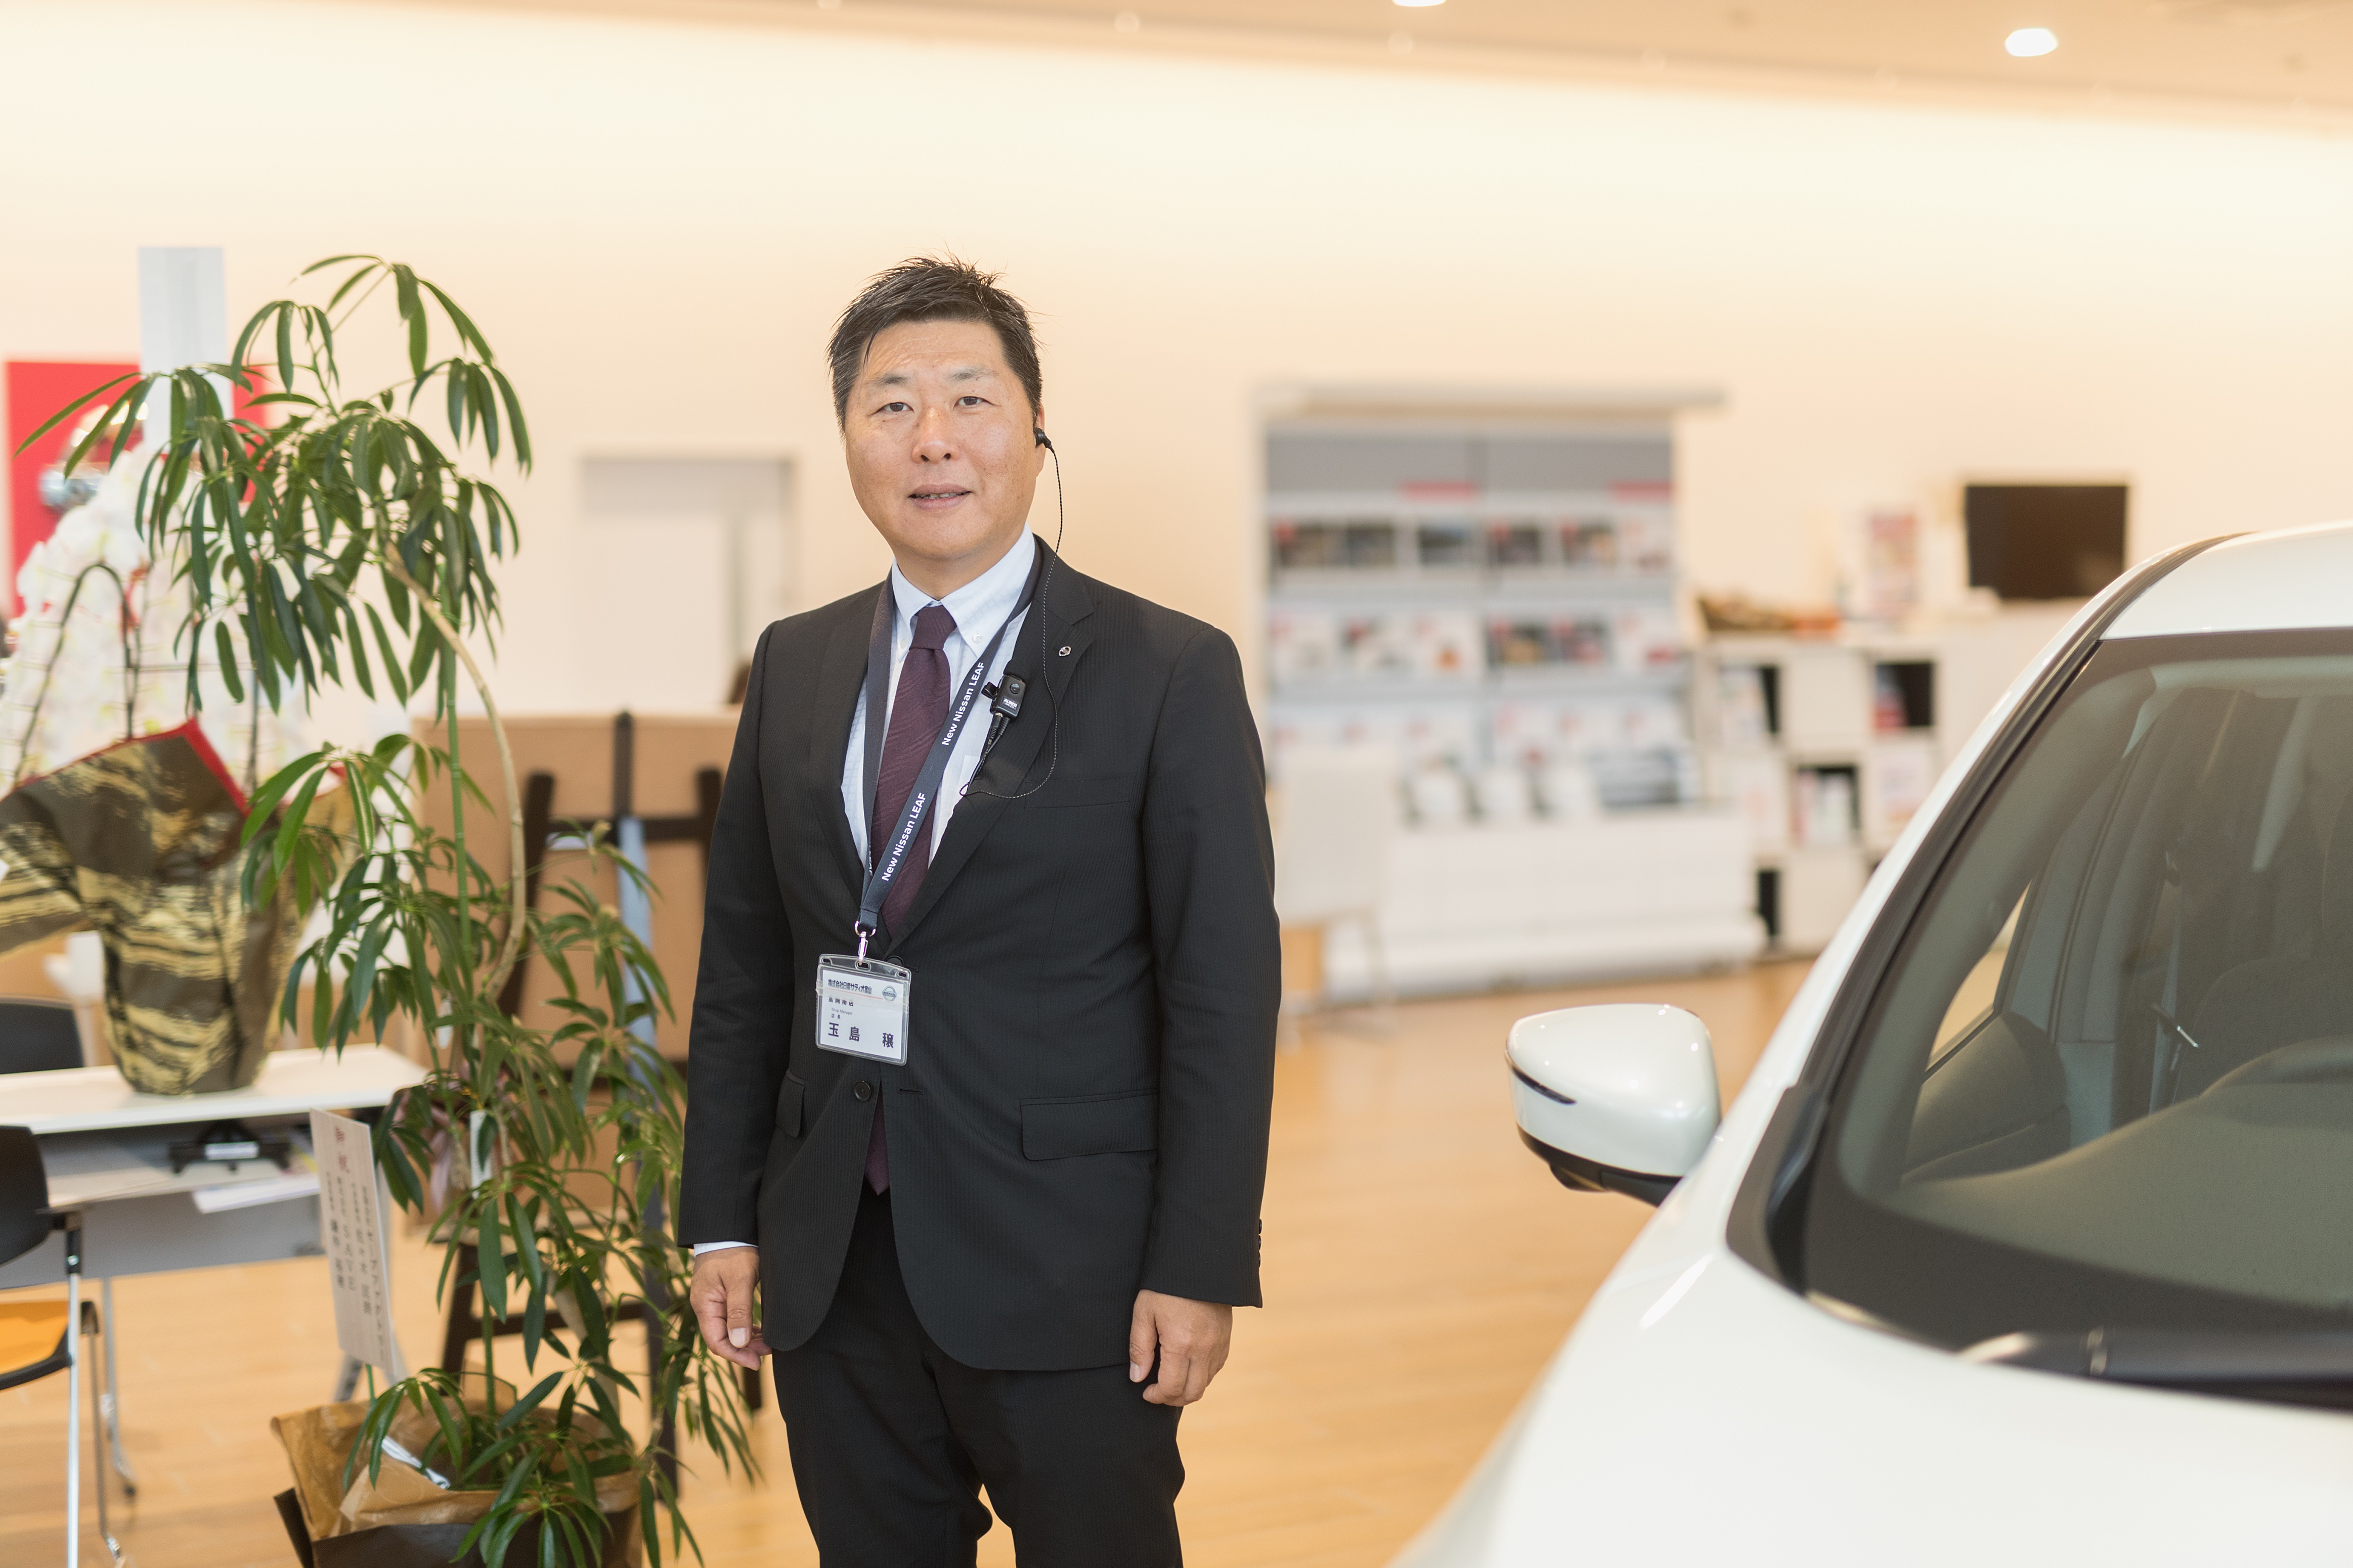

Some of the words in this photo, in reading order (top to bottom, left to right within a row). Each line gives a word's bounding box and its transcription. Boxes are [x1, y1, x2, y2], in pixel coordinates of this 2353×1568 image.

[941, 723, 957, 746] New
[953, 688, 974, 722] Nissan
[969, 662, 984, 686] LEAF
[881, 857, 898, 881] New
[893, 820, 915, 856] Nissan
[909, 792, 926, 819] LEAF
